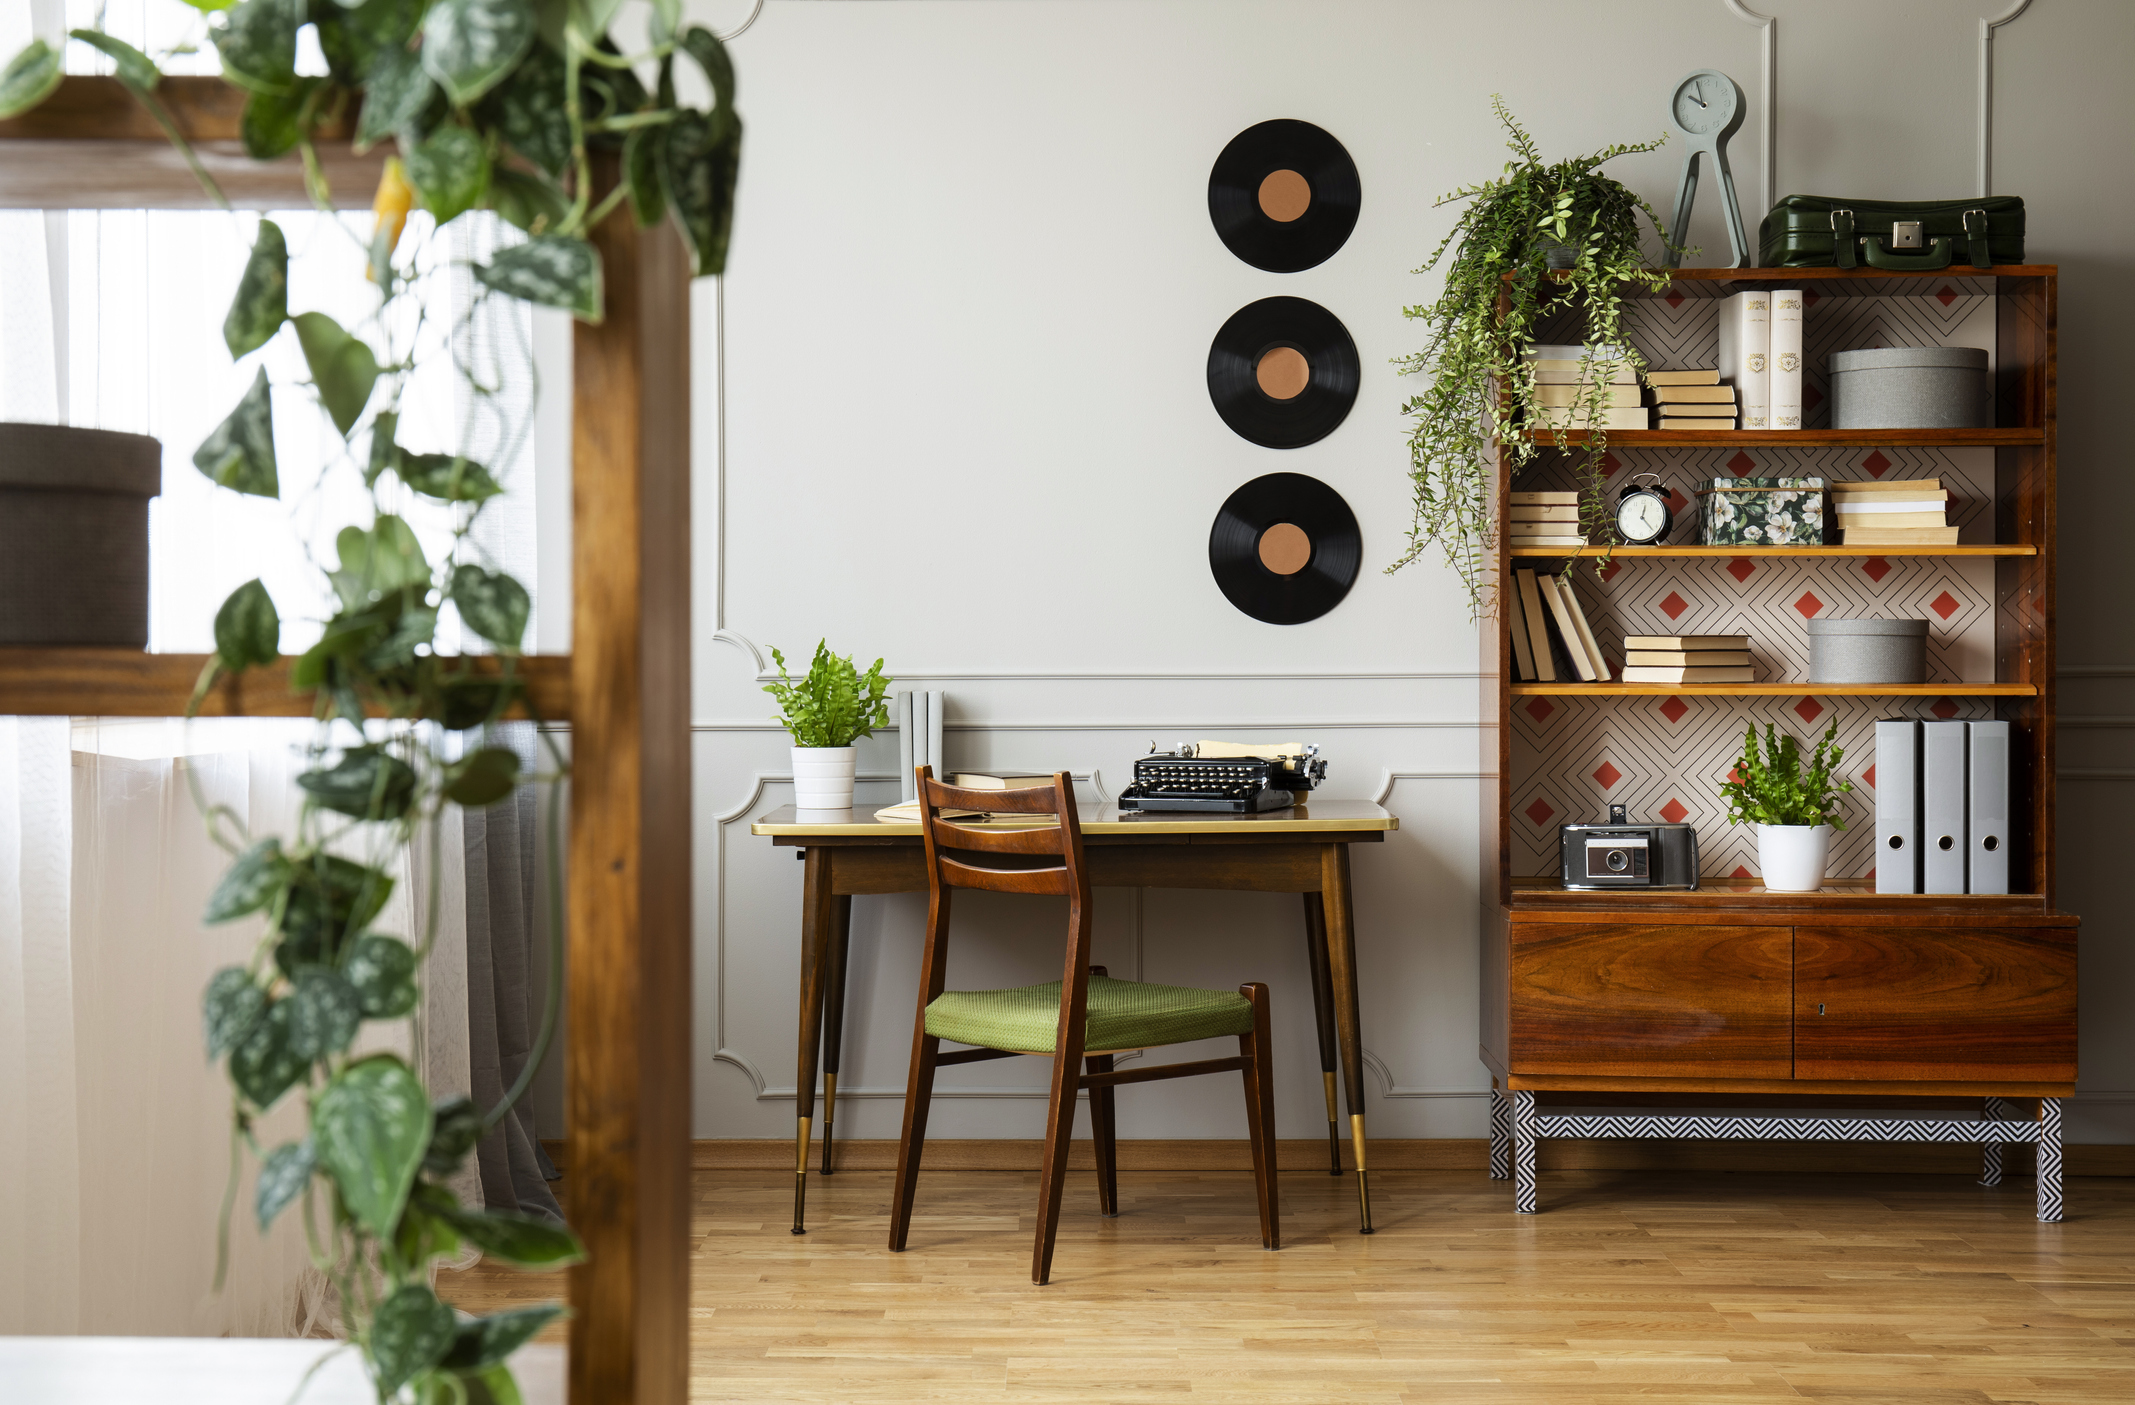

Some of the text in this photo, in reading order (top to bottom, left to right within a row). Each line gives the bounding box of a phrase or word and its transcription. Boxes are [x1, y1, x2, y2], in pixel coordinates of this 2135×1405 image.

[1720, 88, 1728, 96] 2
[1724, 99, 1731, 107] 3
[1713, 120, 1720, 128] 5
